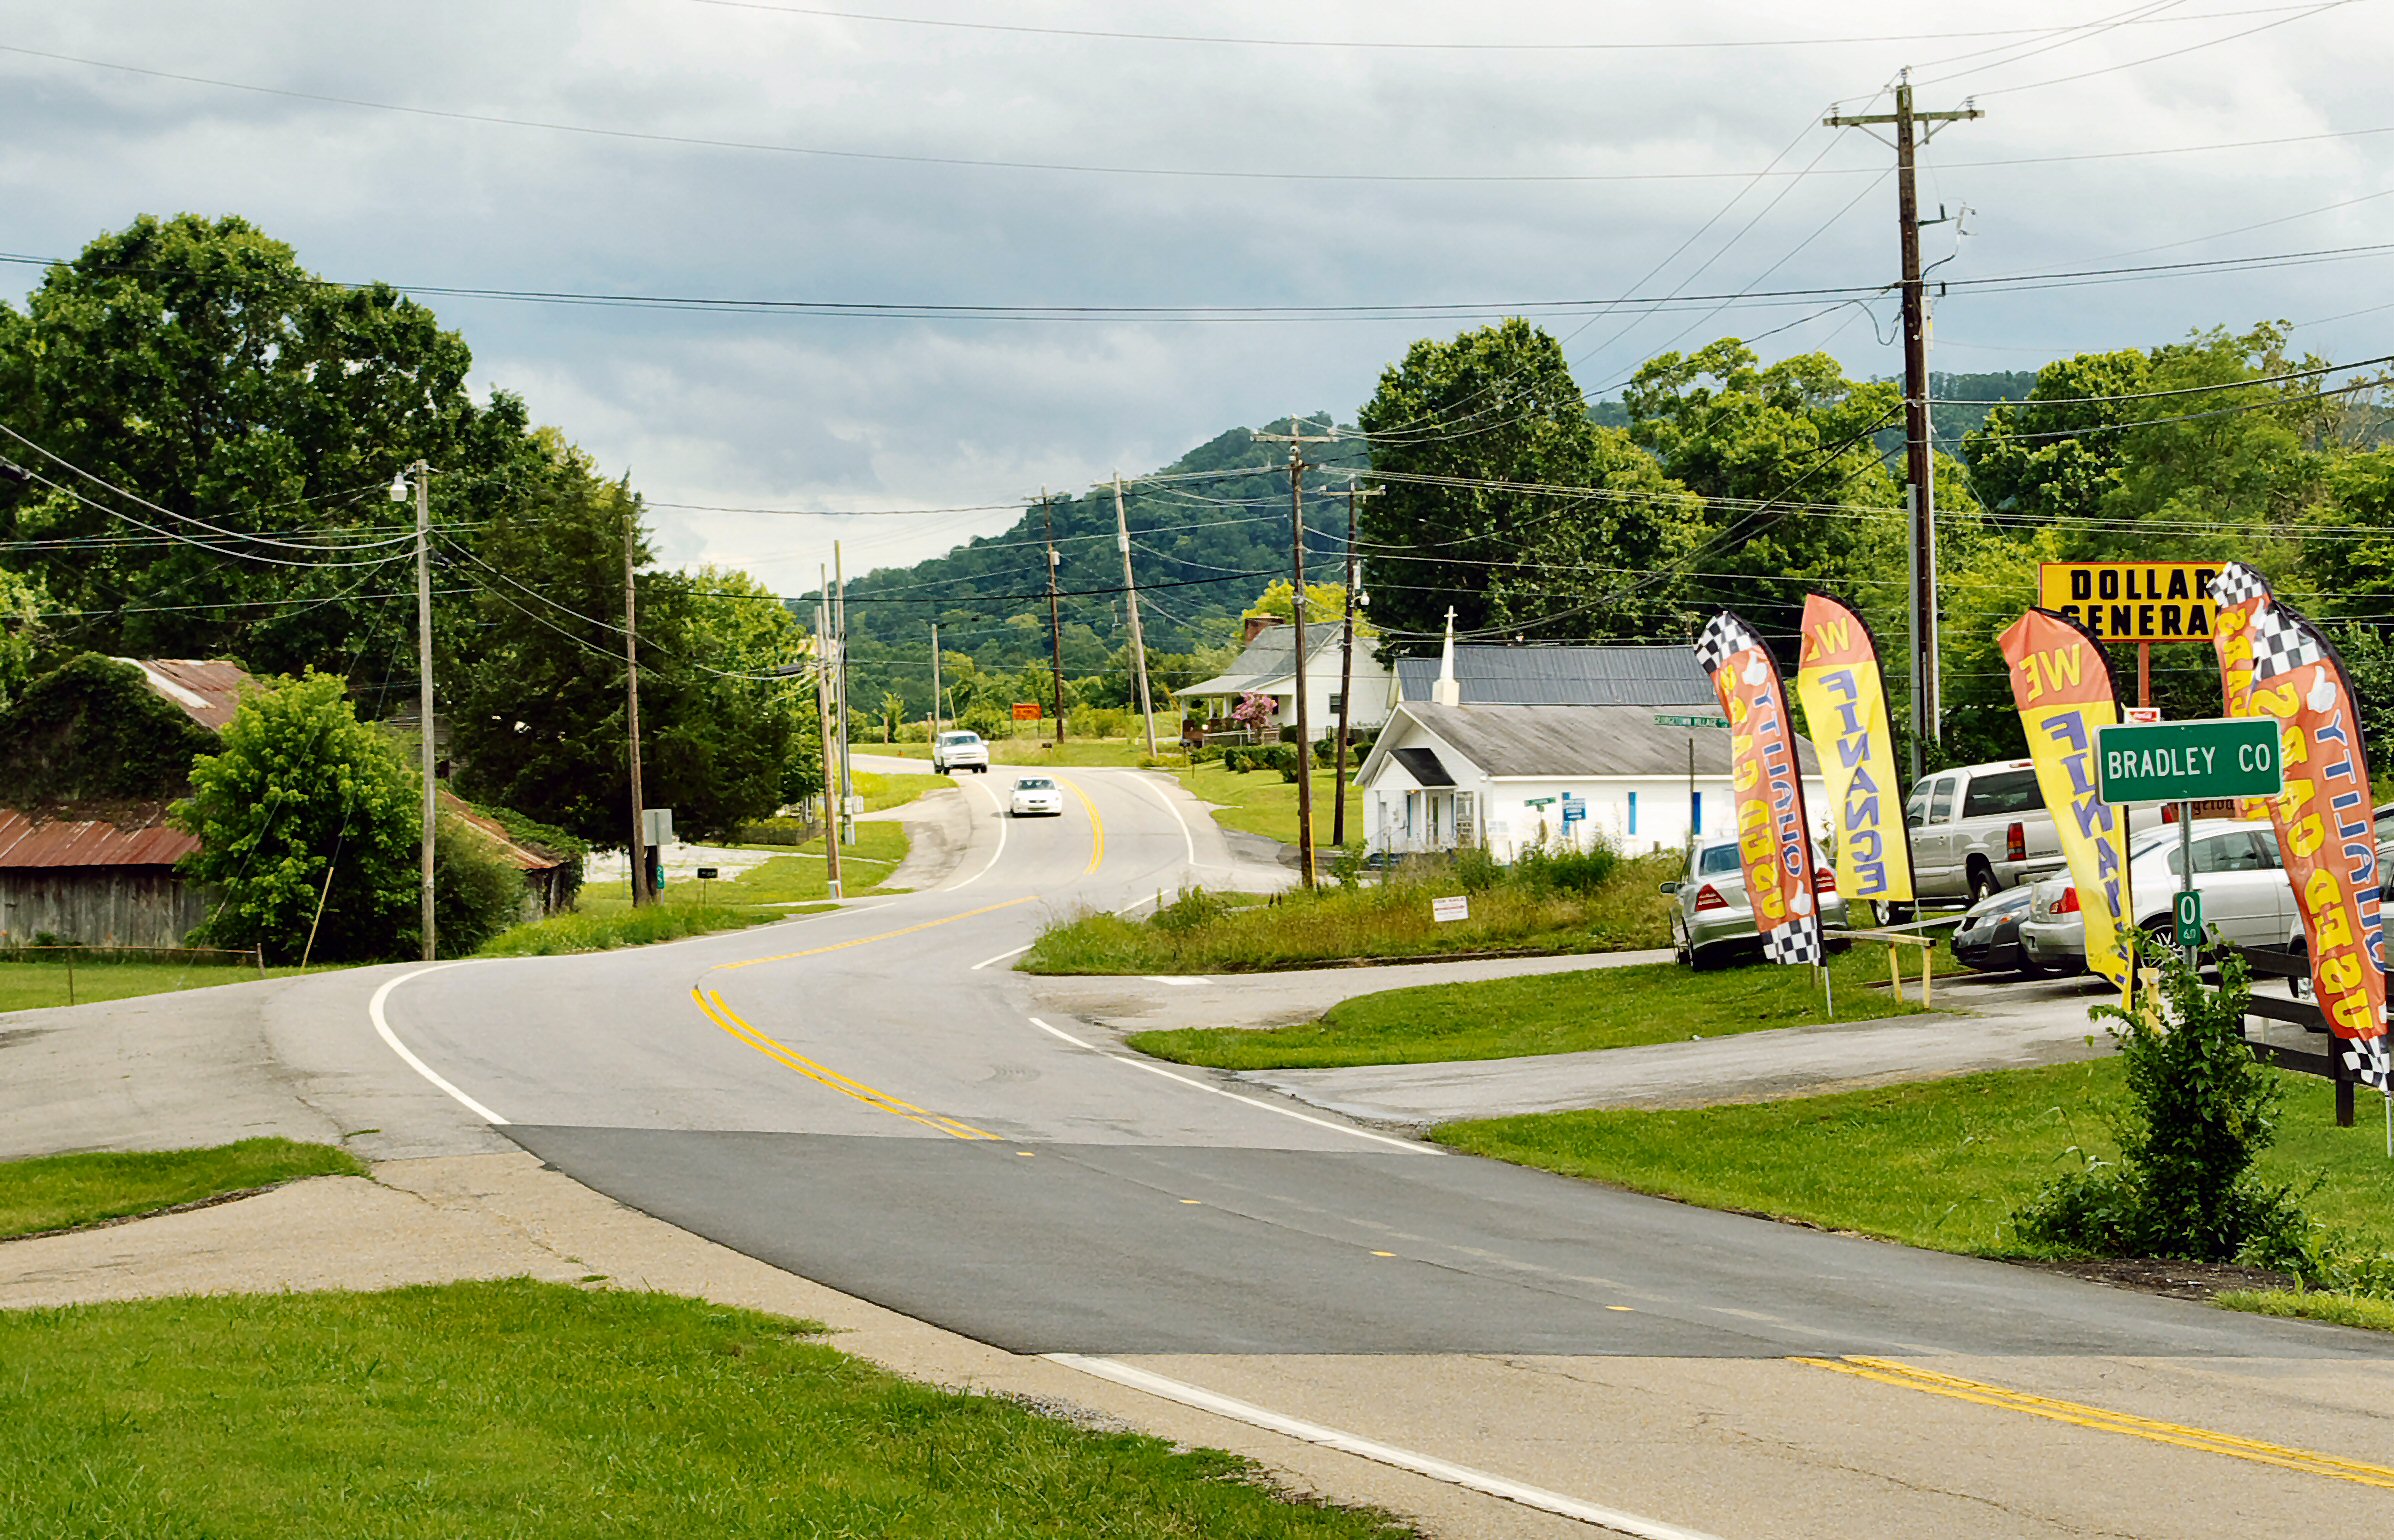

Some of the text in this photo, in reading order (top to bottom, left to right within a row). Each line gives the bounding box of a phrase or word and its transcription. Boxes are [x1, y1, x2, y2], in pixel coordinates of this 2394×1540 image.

[2070, 568, 2216, 600] DOLLAR
[2060, 604, 2220, 636] GENERA
[2107, 743, 2271, 780] BRADLEY CO
[2180, 895, 2196, 925] 0
